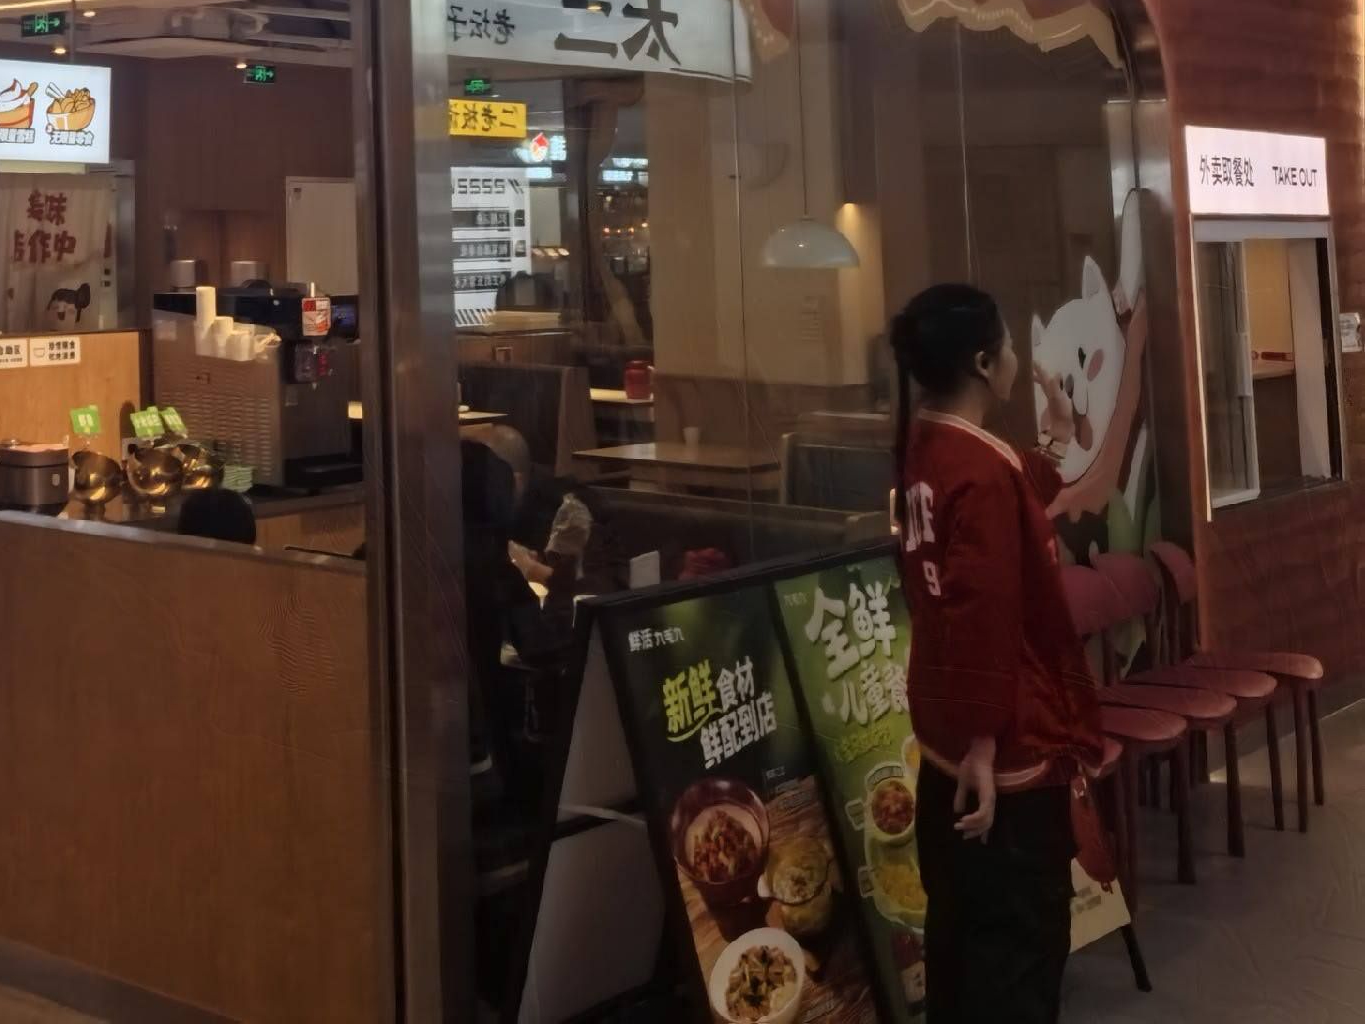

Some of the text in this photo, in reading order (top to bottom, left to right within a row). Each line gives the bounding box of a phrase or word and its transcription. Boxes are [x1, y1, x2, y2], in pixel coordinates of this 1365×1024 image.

[1199, 154, 1255, 188] 外卖取餐处
[1272, 165, 1318, 187] TAKE OUT
[628, 627, 685, 652] 鲜活 九毛九
[804, 580, 898, 681] 全鲜
[662, 655, 756, 734] 新鲜食材
[699, 690, 778, 770] 鲜配到店
